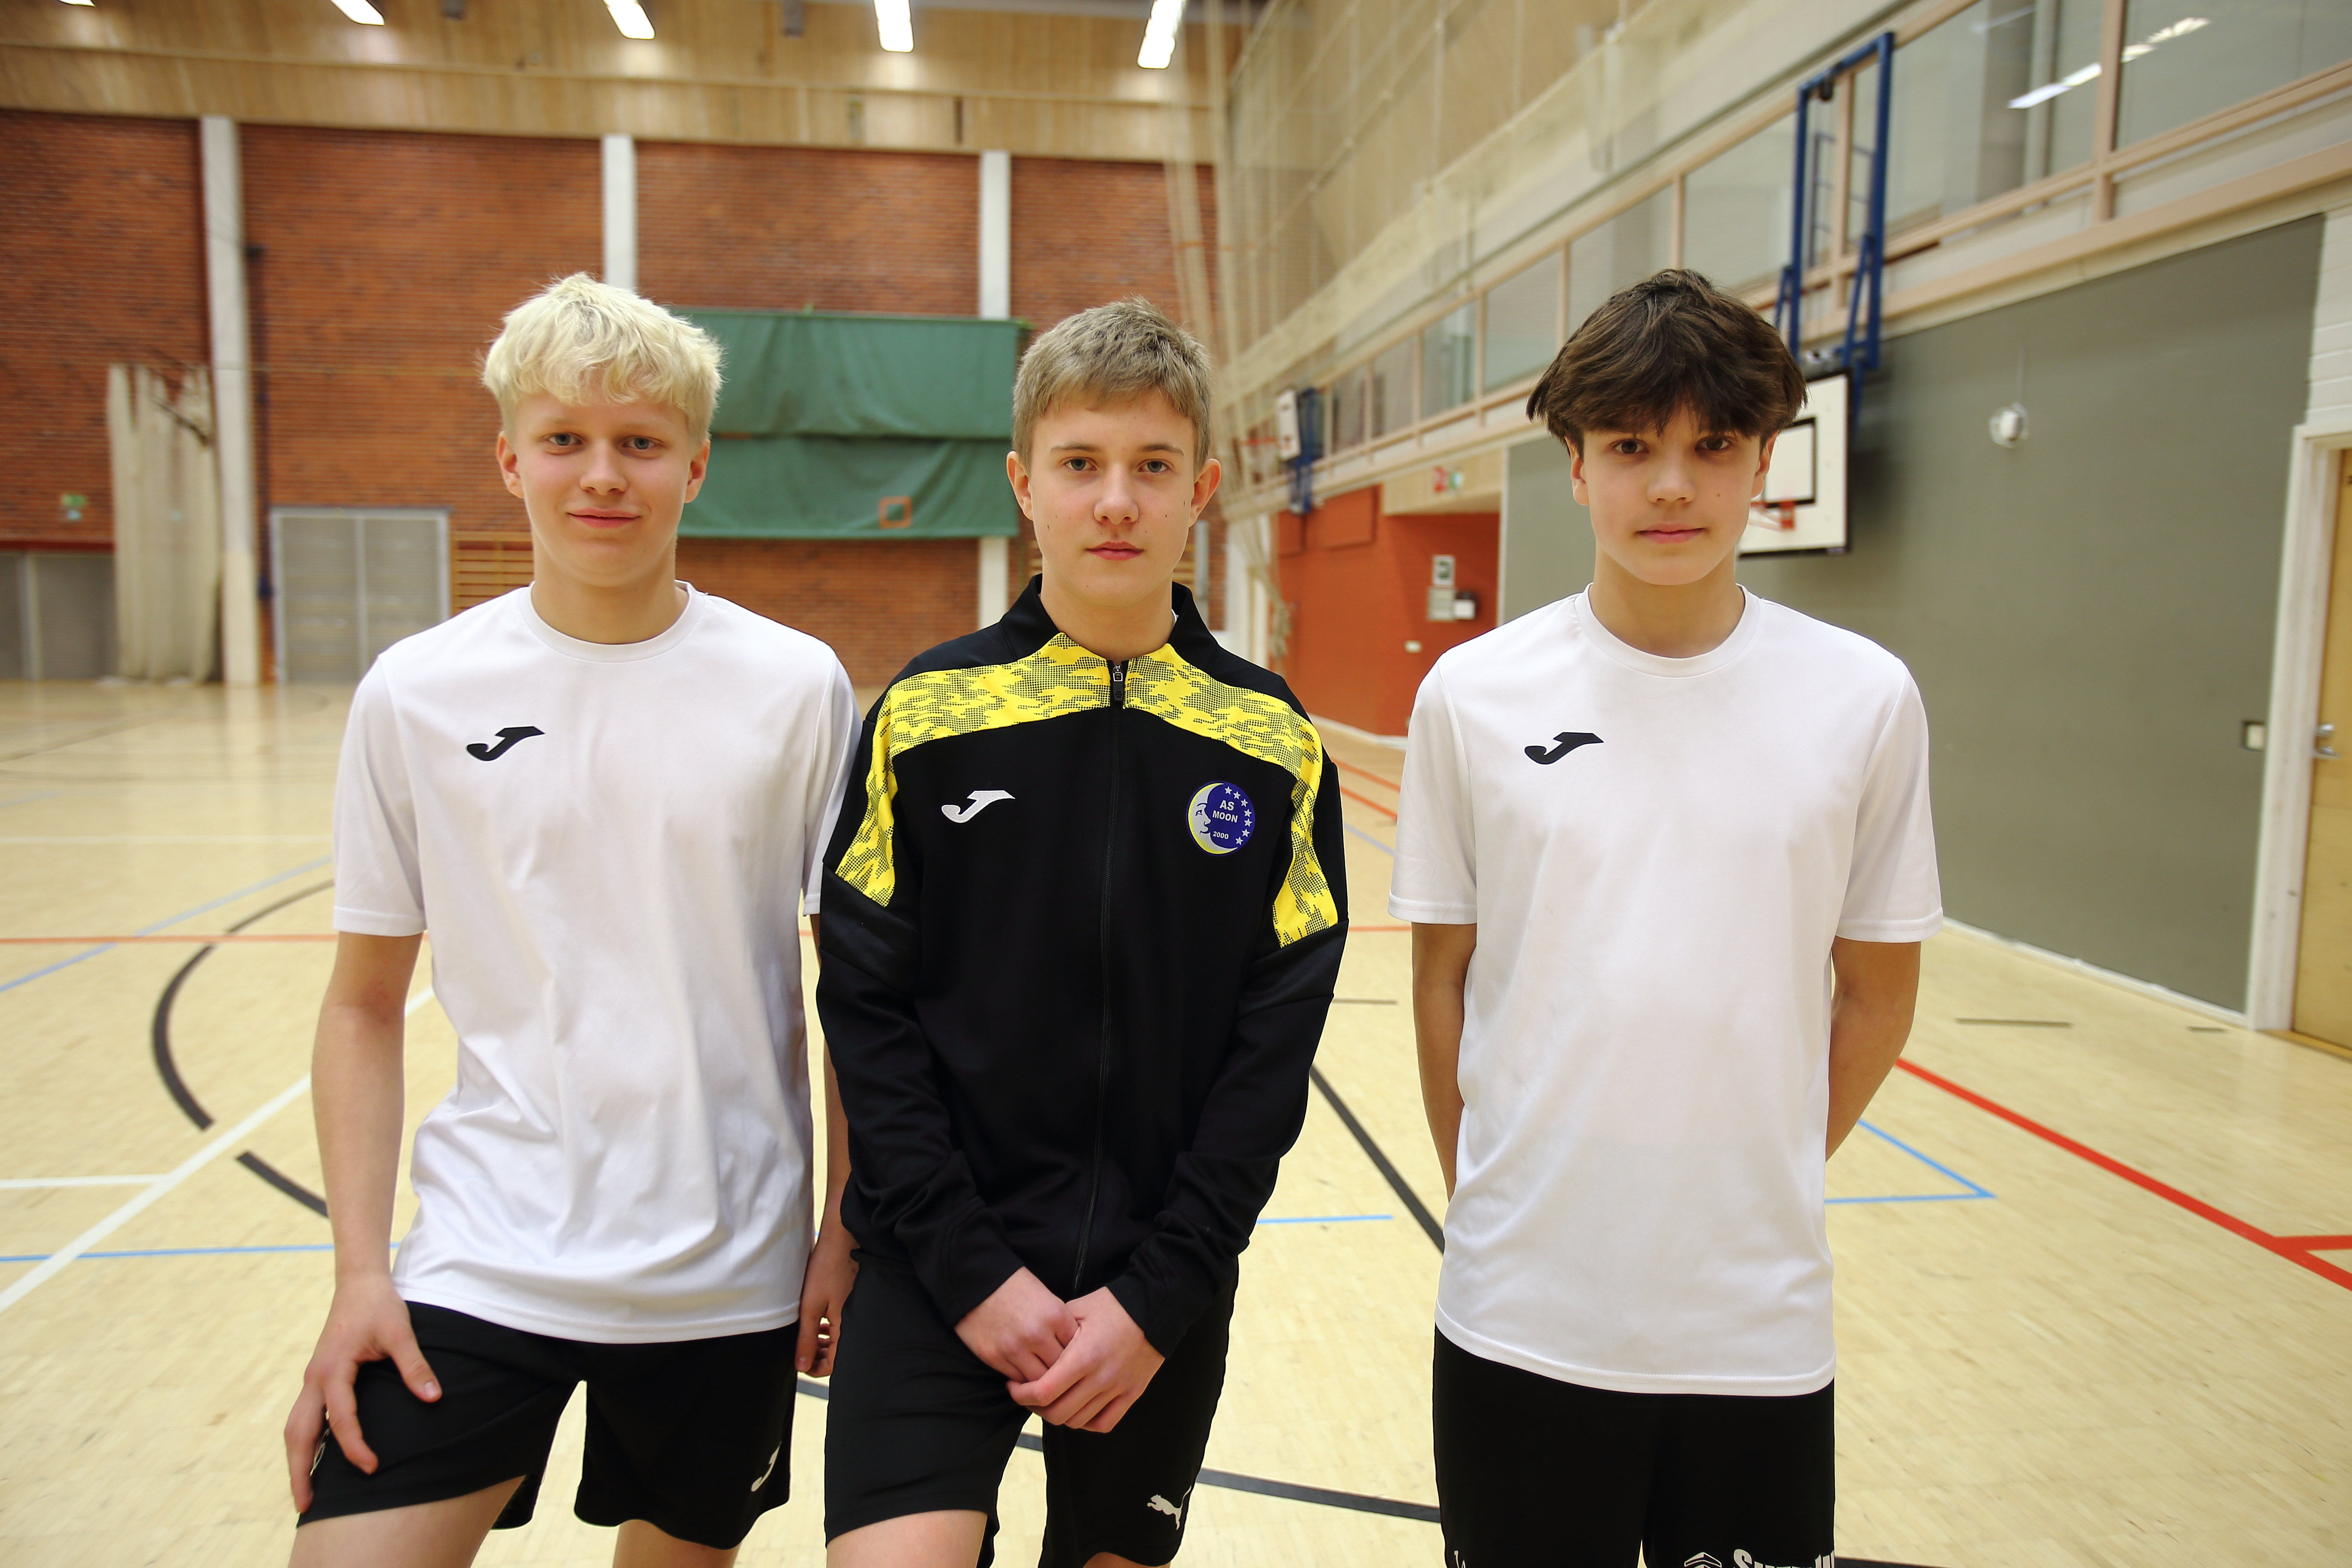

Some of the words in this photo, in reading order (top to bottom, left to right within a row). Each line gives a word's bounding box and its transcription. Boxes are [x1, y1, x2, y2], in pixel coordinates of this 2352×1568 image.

[1219, 800, 1234, 811] AS
[1213, 810, 1238, 823] MOON
[1213, 831, 1229, 840] 2000
